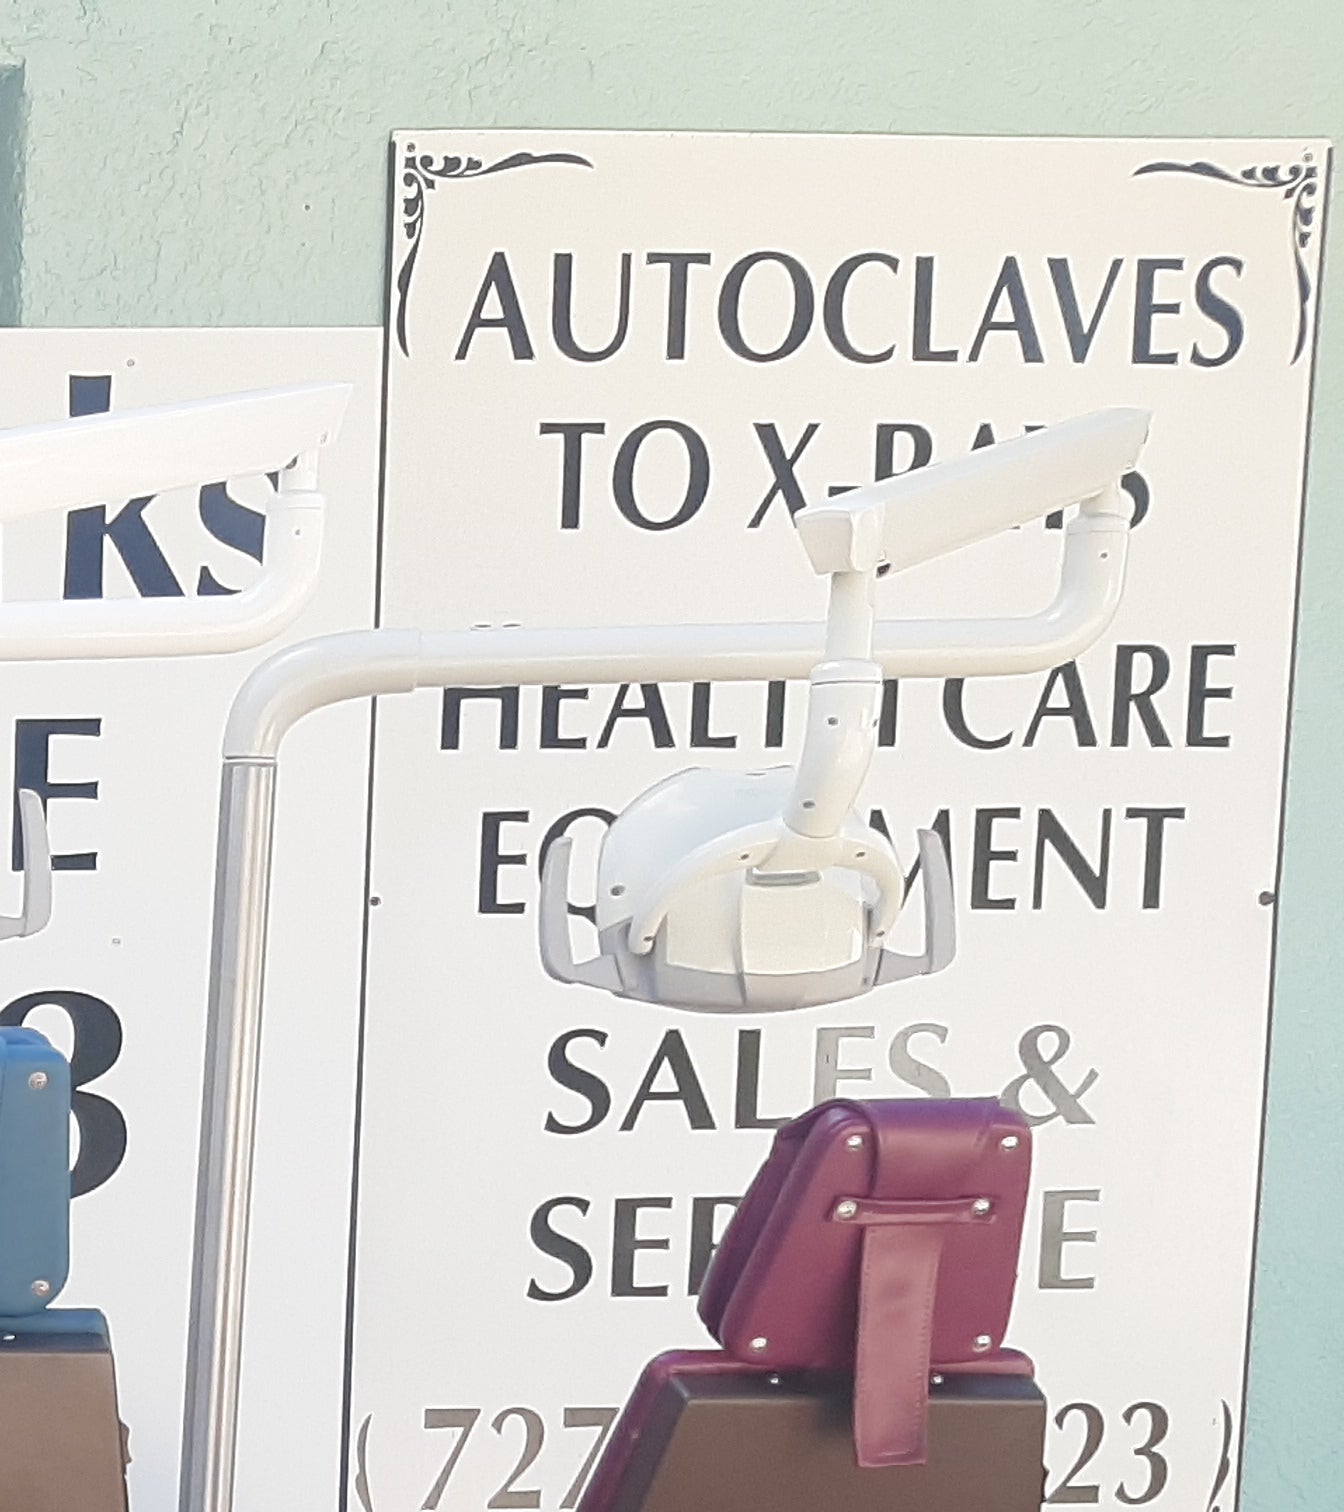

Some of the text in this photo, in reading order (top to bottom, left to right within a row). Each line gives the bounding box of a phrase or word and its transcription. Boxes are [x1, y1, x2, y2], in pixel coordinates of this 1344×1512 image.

[455, 251, 1245, 367] AUTOCLAVES
[538, 420, 710, 532] TO
[942, 643, 1238, 750] CARE
[543, 1022, 1100, 1135] SALES &
